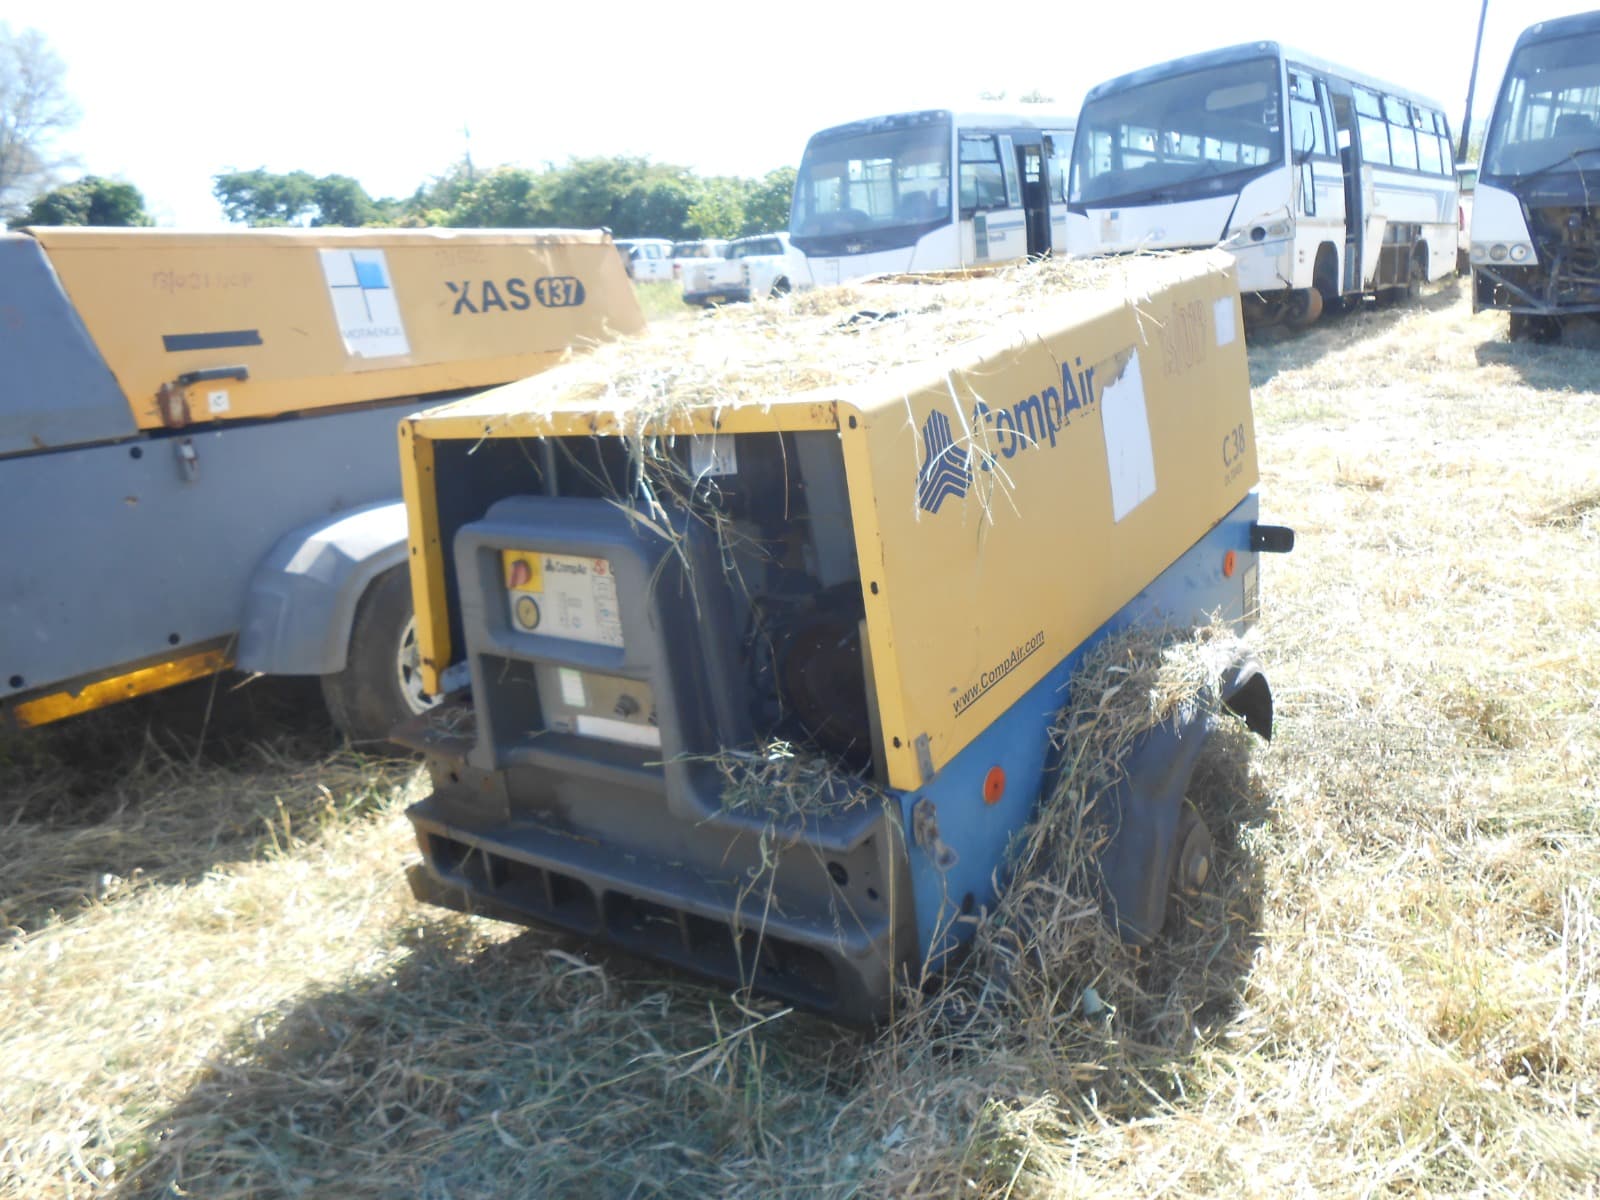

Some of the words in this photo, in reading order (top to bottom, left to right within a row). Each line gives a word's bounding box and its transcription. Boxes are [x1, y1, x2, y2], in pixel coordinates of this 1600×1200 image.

[444, 278, 531, 315] XAS
[538, 278, 579, 306] 137
[952, 630, 1045, 715] www.CompAir.com
